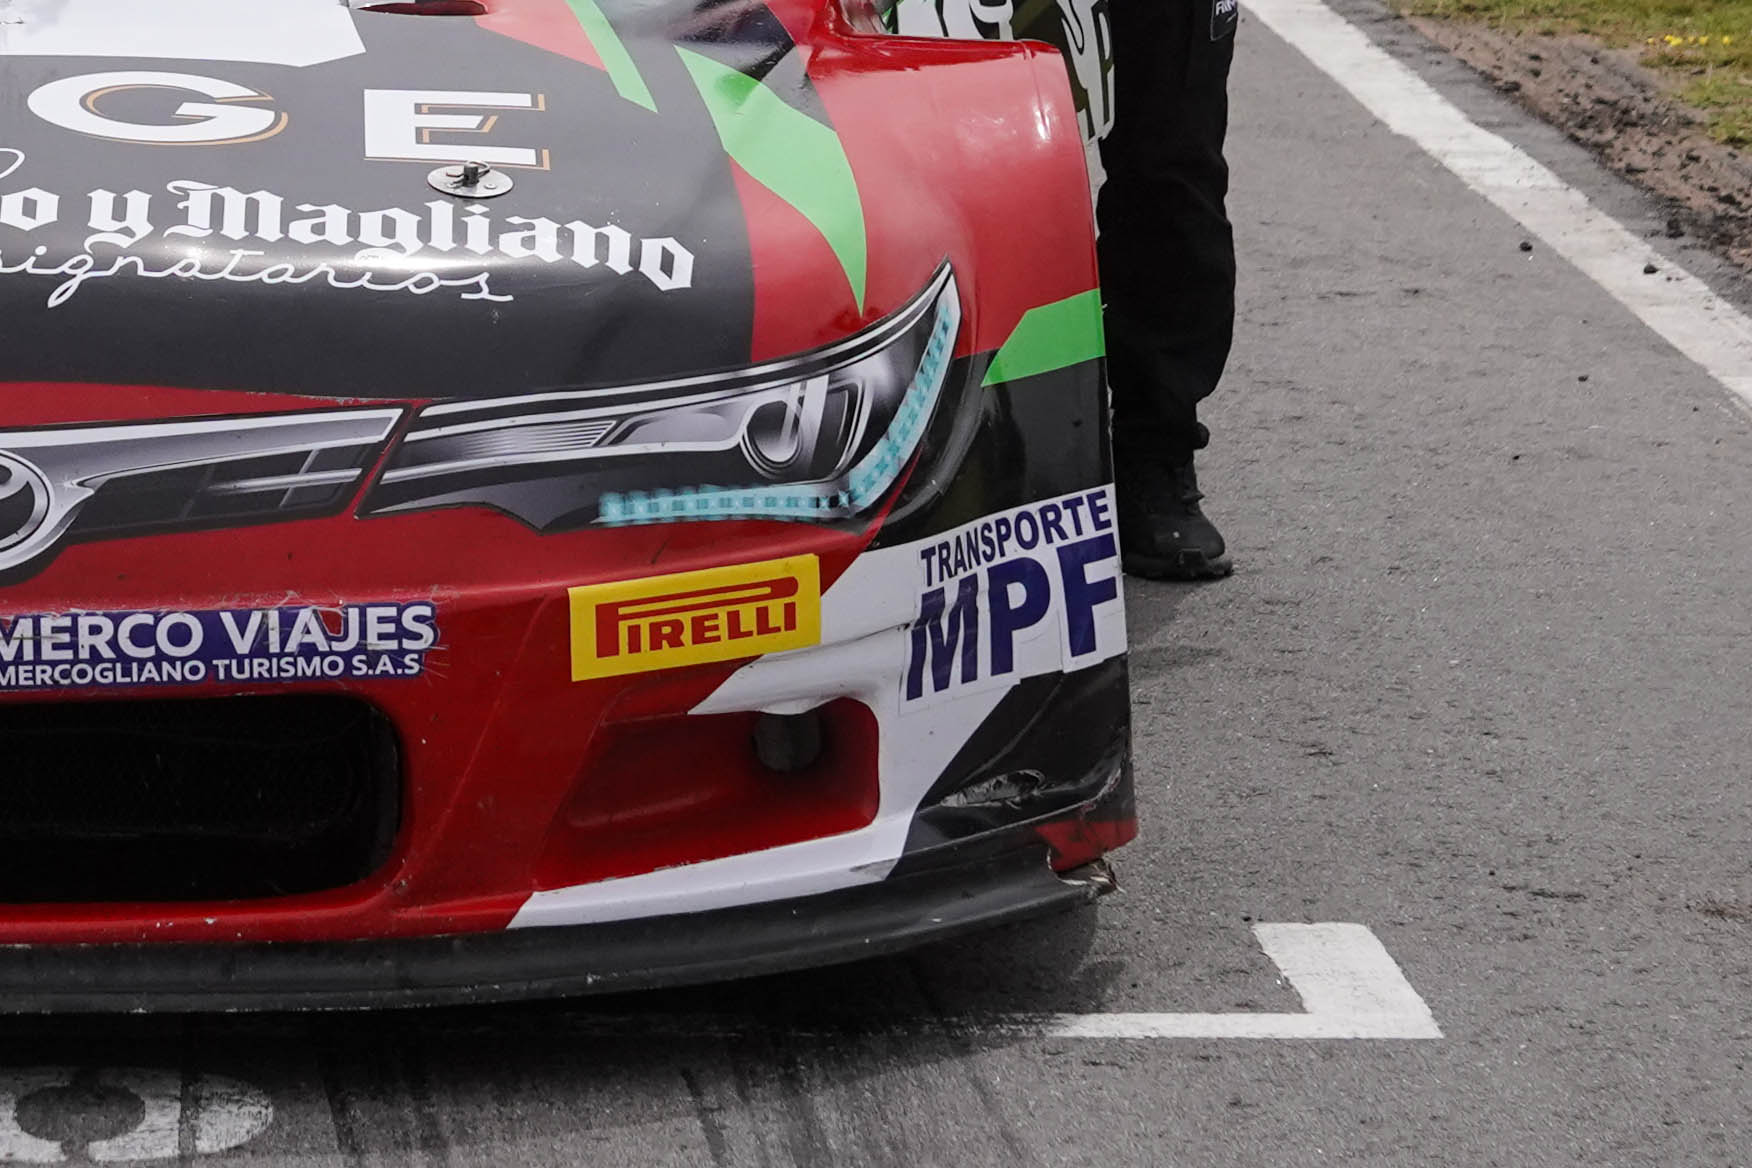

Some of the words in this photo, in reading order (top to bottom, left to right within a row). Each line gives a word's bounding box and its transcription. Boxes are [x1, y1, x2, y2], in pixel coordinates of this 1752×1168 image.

[87, 184, 154, 248] y
[162, 179, 695, 292] Magliano
[920, 490, 1113, 588] TRANSPORTE
[218, 604, 437, 655] VIAJES
[594, 575, 800, 658] PIRELLI
[905, 533, 1119, 701] MPF
[211, 654, 345, 681] TURISMO
